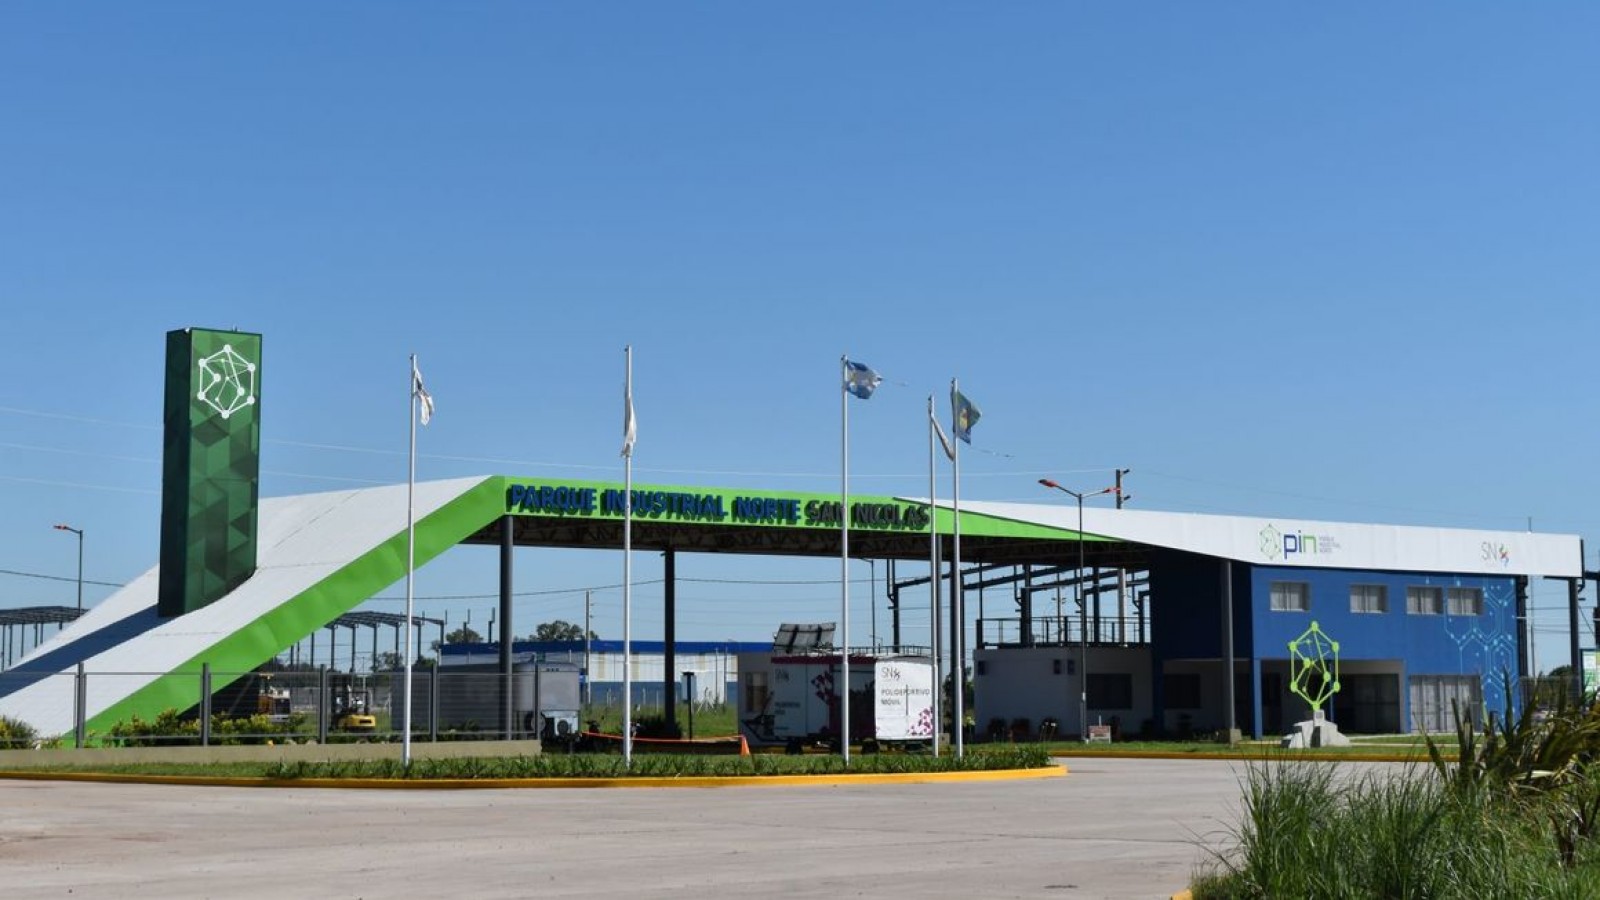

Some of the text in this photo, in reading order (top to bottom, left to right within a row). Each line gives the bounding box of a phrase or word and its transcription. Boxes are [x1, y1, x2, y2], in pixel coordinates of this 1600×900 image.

[507, 484, 597, 514] PARQUE
[602, 488, 728, 520] INDUSTRIAL
[733, 496, 801, 523] NORTE
[805, 500, 846, 526] SAN
[1283, 529, 1316, 560] pin
[1480, 541, 1497, 561] SN
